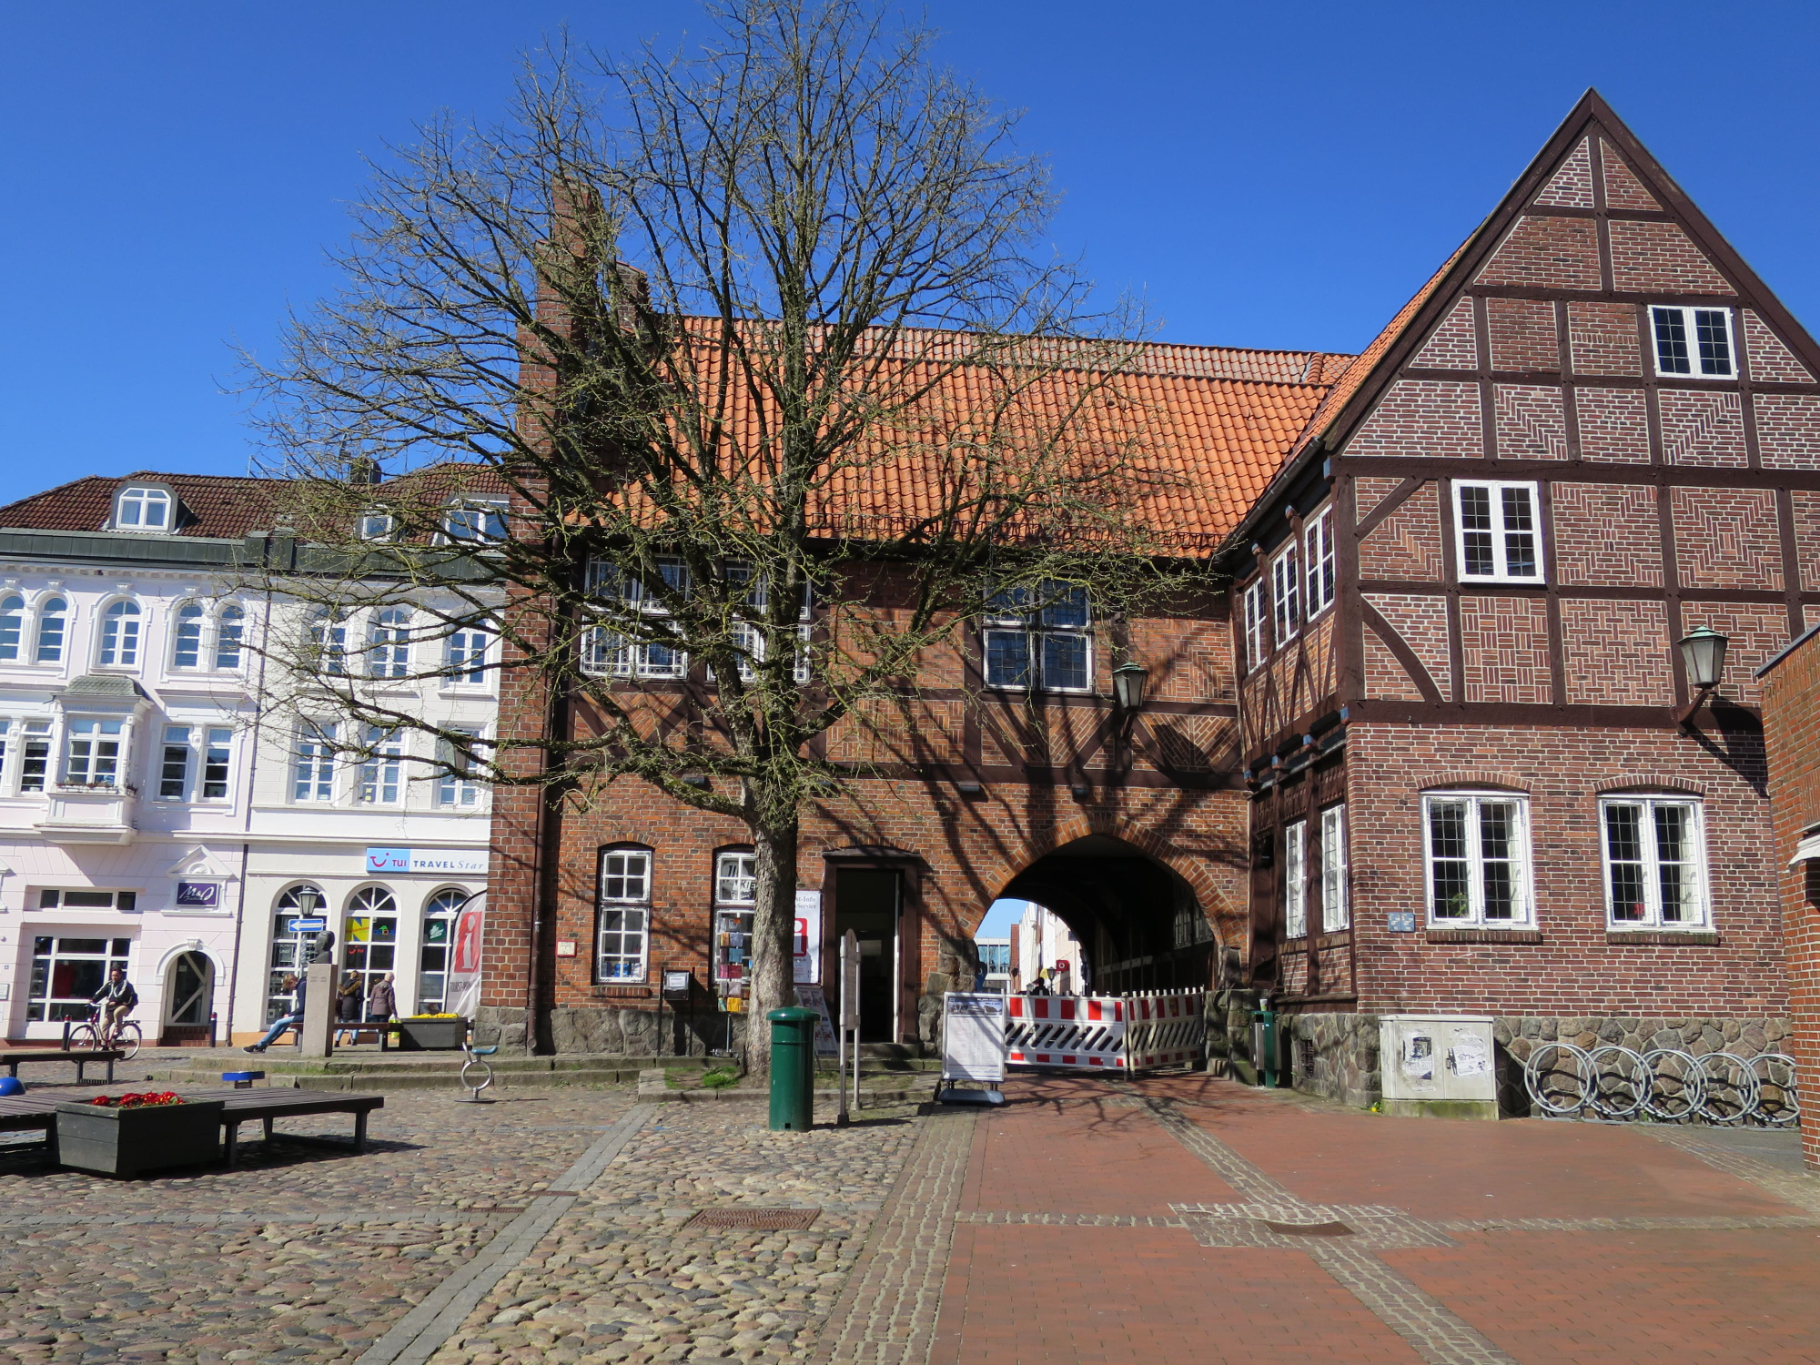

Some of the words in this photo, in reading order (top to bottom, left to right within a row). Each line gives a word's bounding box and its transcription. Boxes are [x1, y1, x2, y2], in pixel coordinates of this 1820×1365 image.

[392, 859, 407, 867] TUI
[413, 860, 455, 868] TRAVEL
[457, 860, 484, 870] Star
